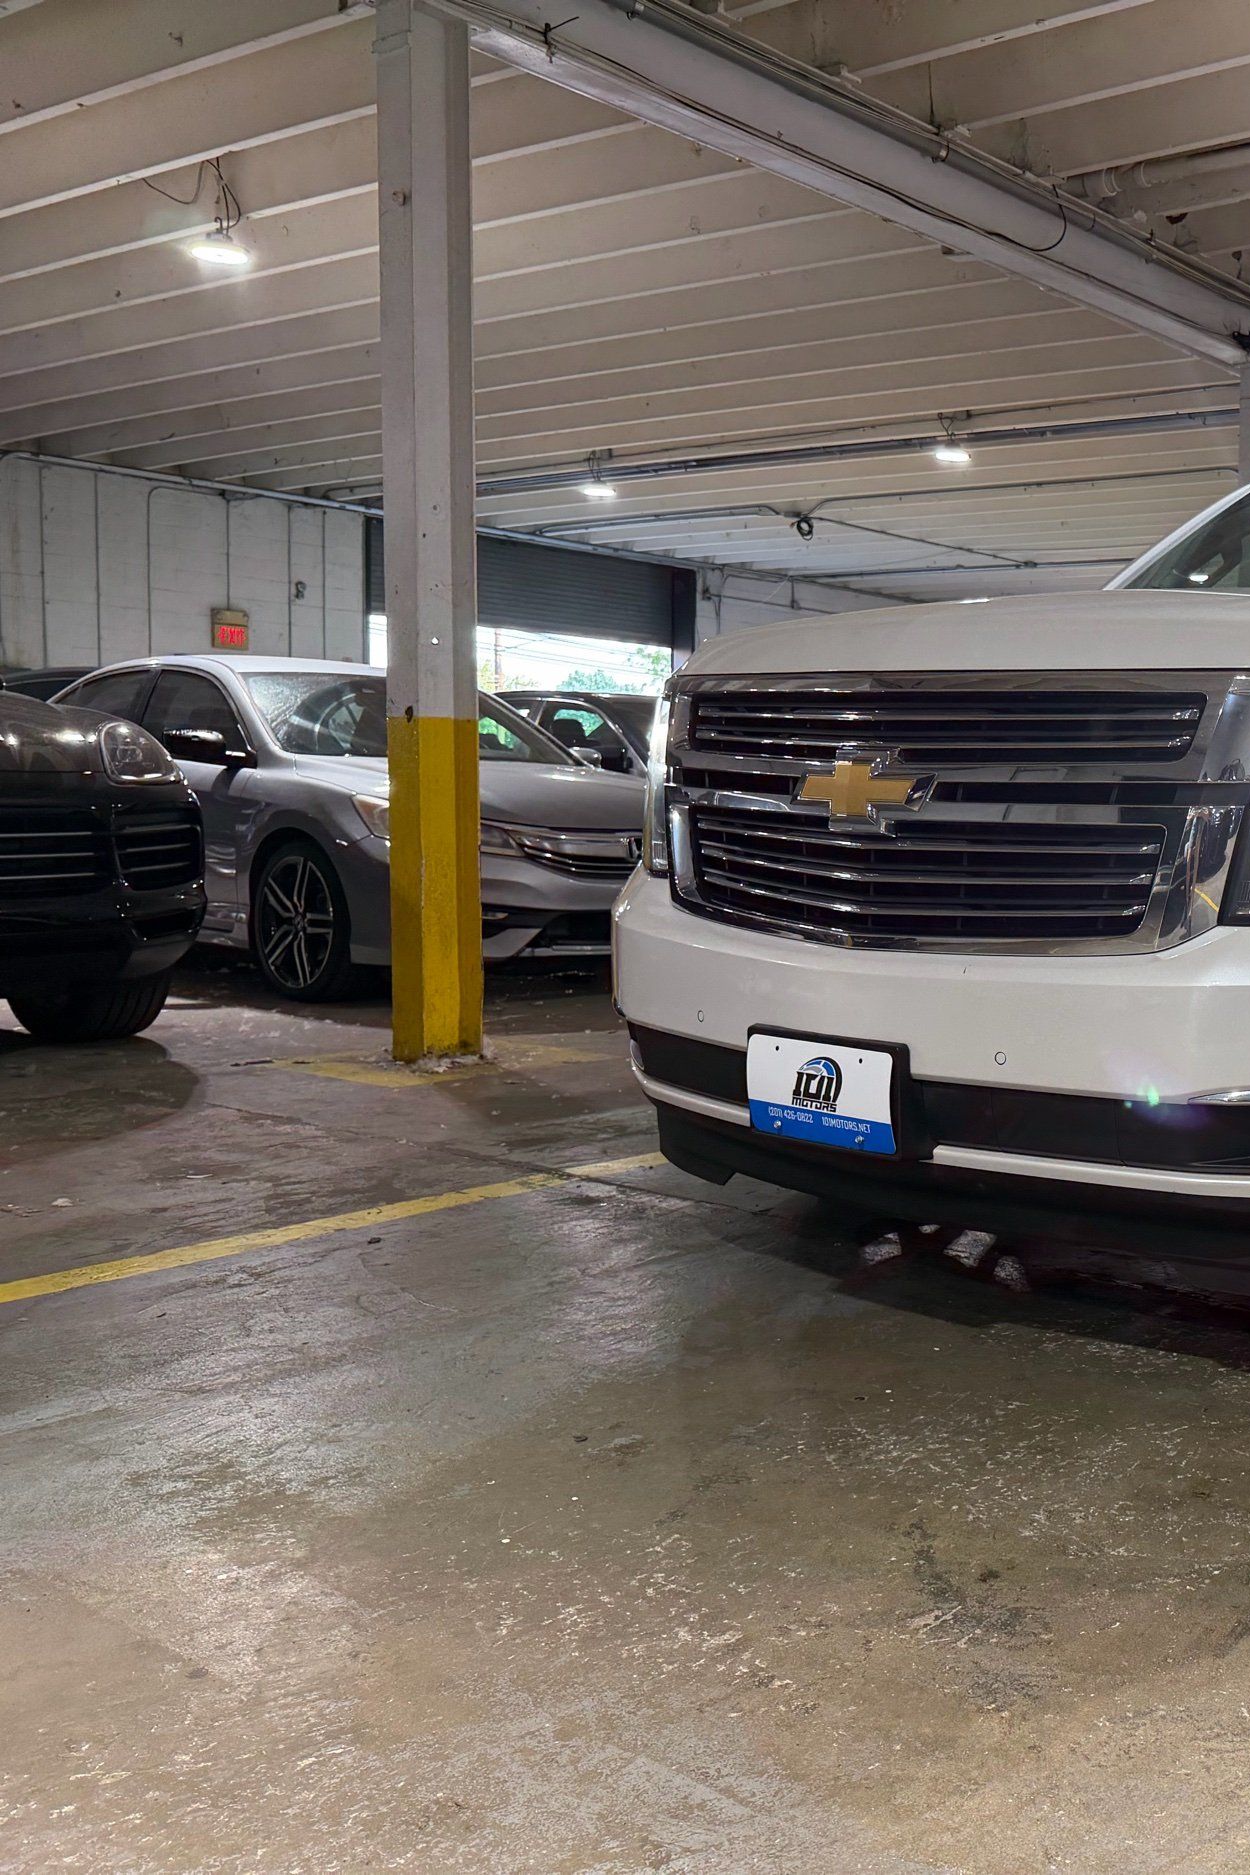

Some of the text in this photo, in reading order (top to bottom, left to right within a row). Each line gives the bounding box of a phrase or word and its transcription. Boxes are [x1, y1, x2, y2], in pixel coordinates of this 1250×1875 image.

[793, 1071, 835, 1103] 101
[792, 1096, 838, 1113] MOTORS
[784, 1108, 814, 1123] 426-0822
[821, 1116, 871, 1134] 101MOTORS.NET
